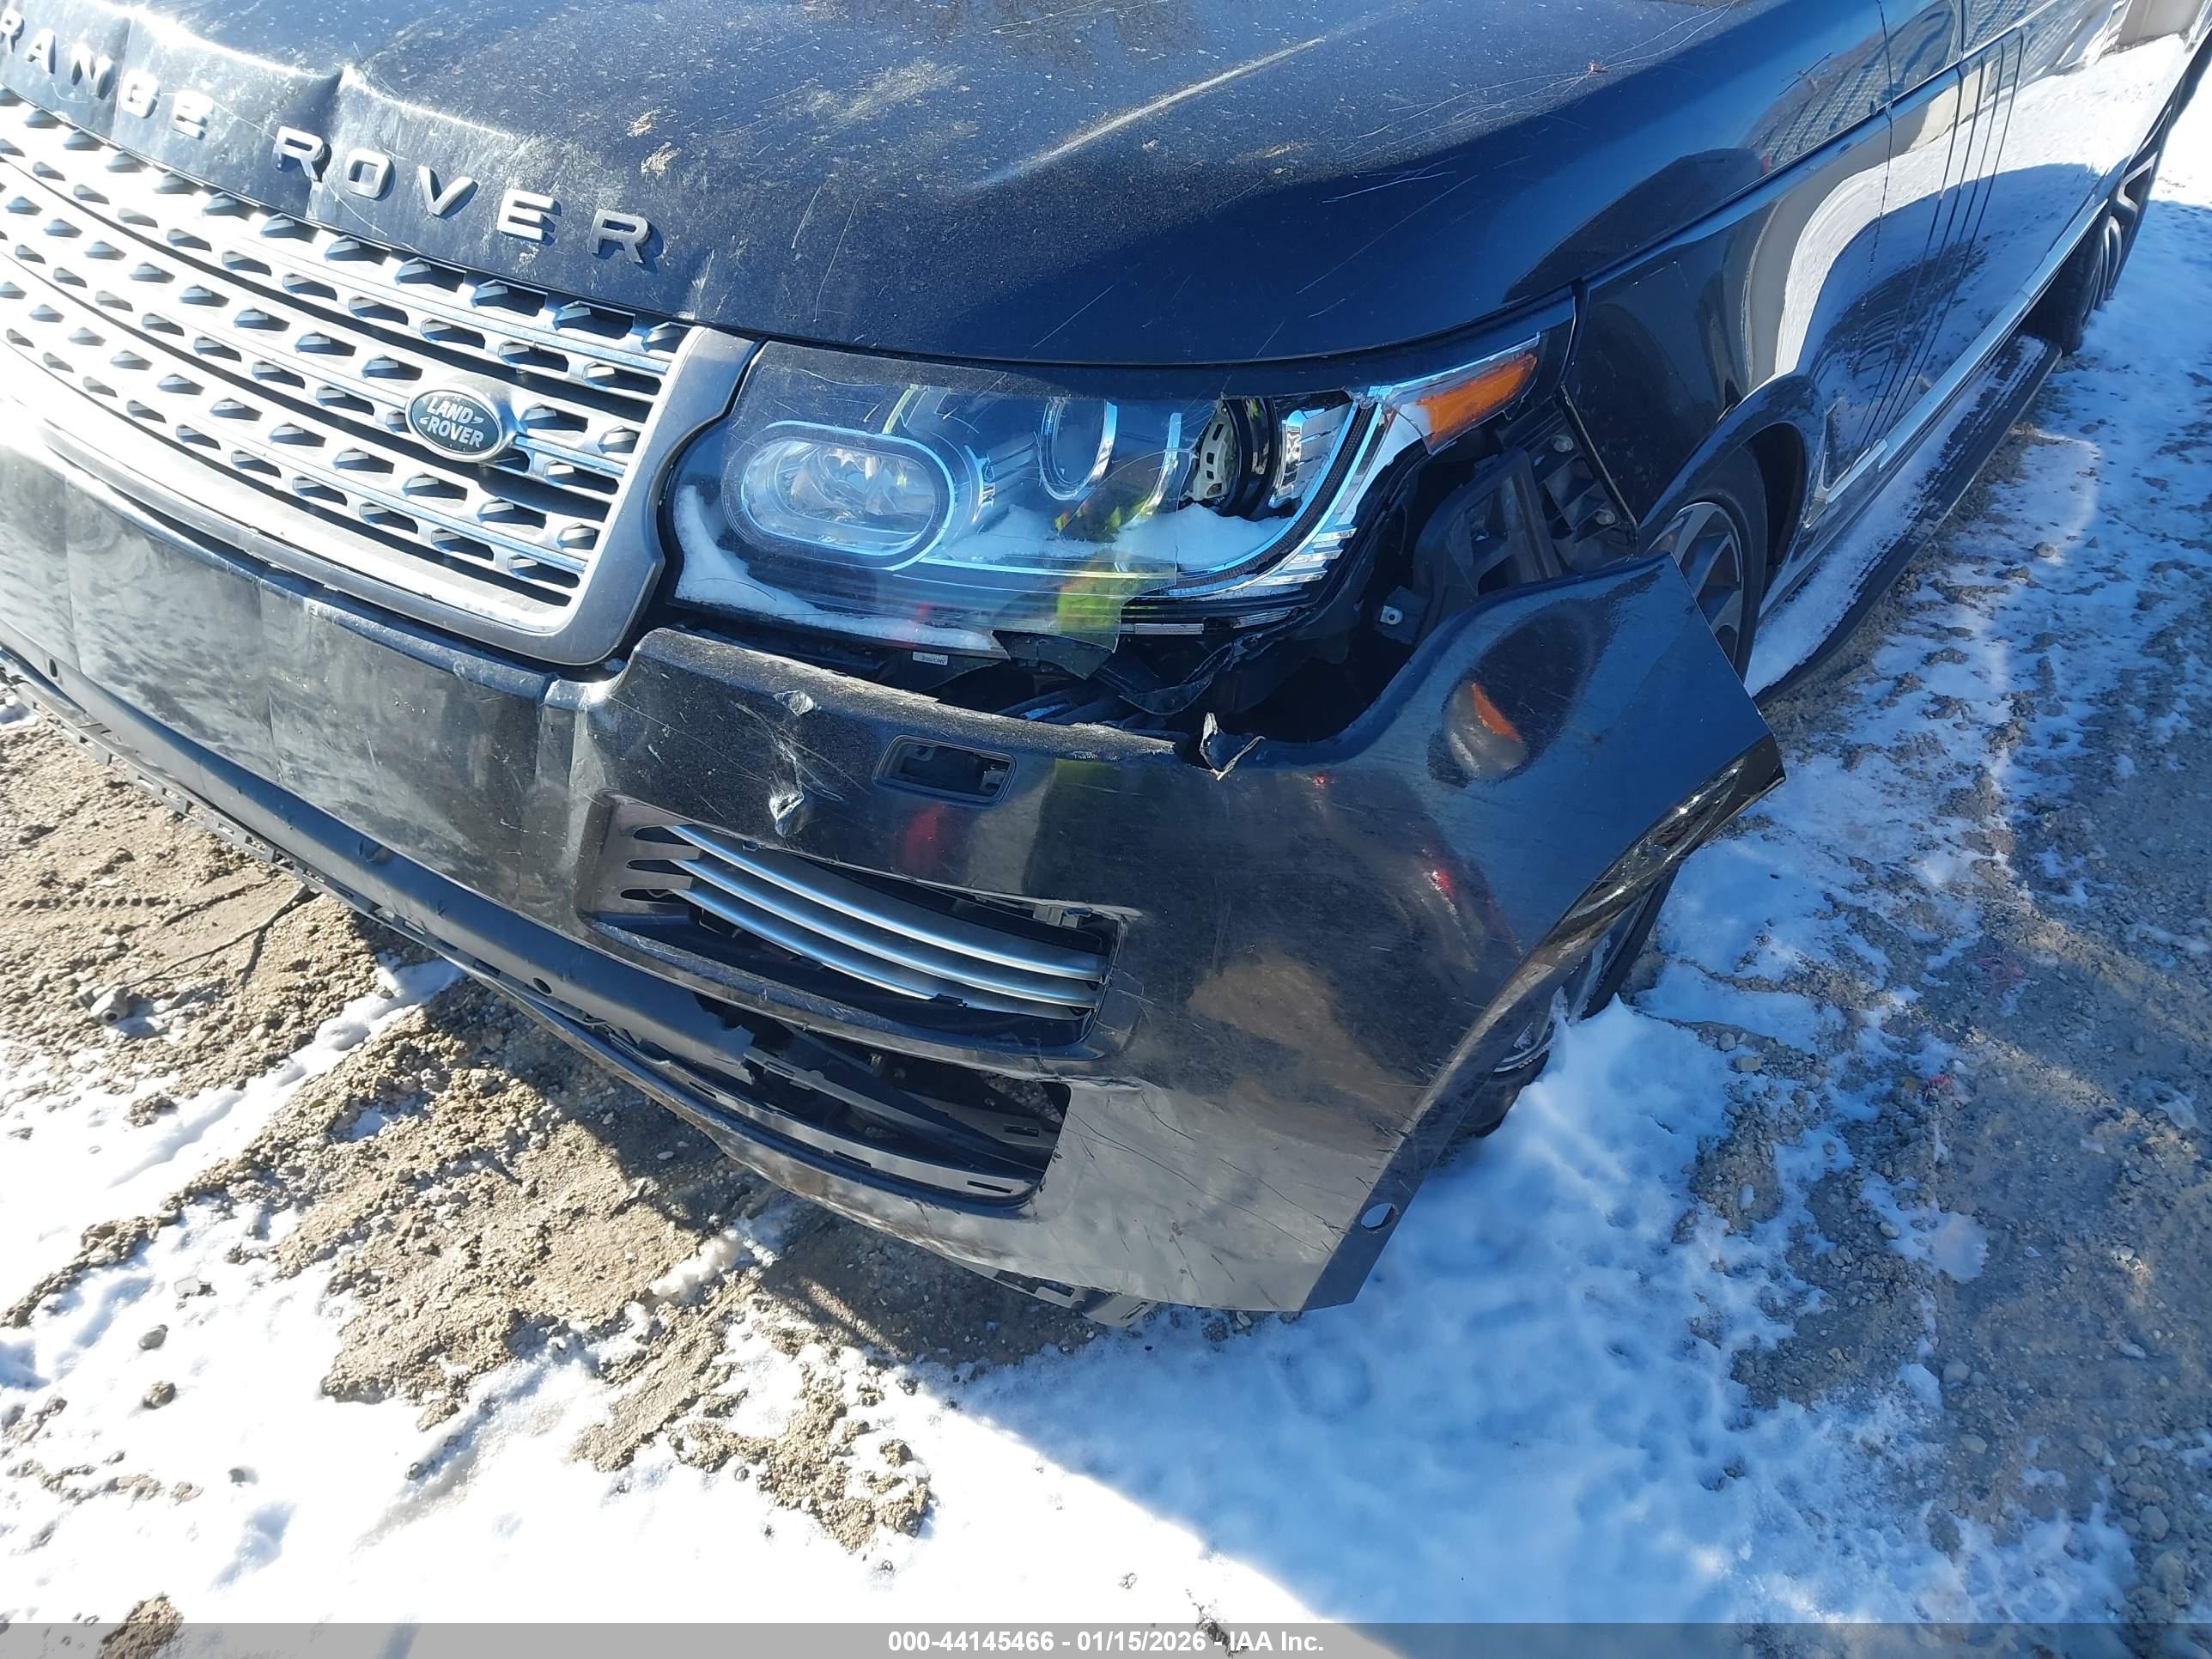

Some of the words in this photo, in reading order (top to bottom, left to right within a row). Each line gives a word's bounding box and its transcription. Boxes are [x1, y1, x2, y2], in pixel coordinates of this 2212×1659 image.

[0, 8, 213, 140] RANGE
[273, 125, 650, 264] ROVER
[427, 397, 474, 423] LAND
[427, 416, 483, 447] ROVER
